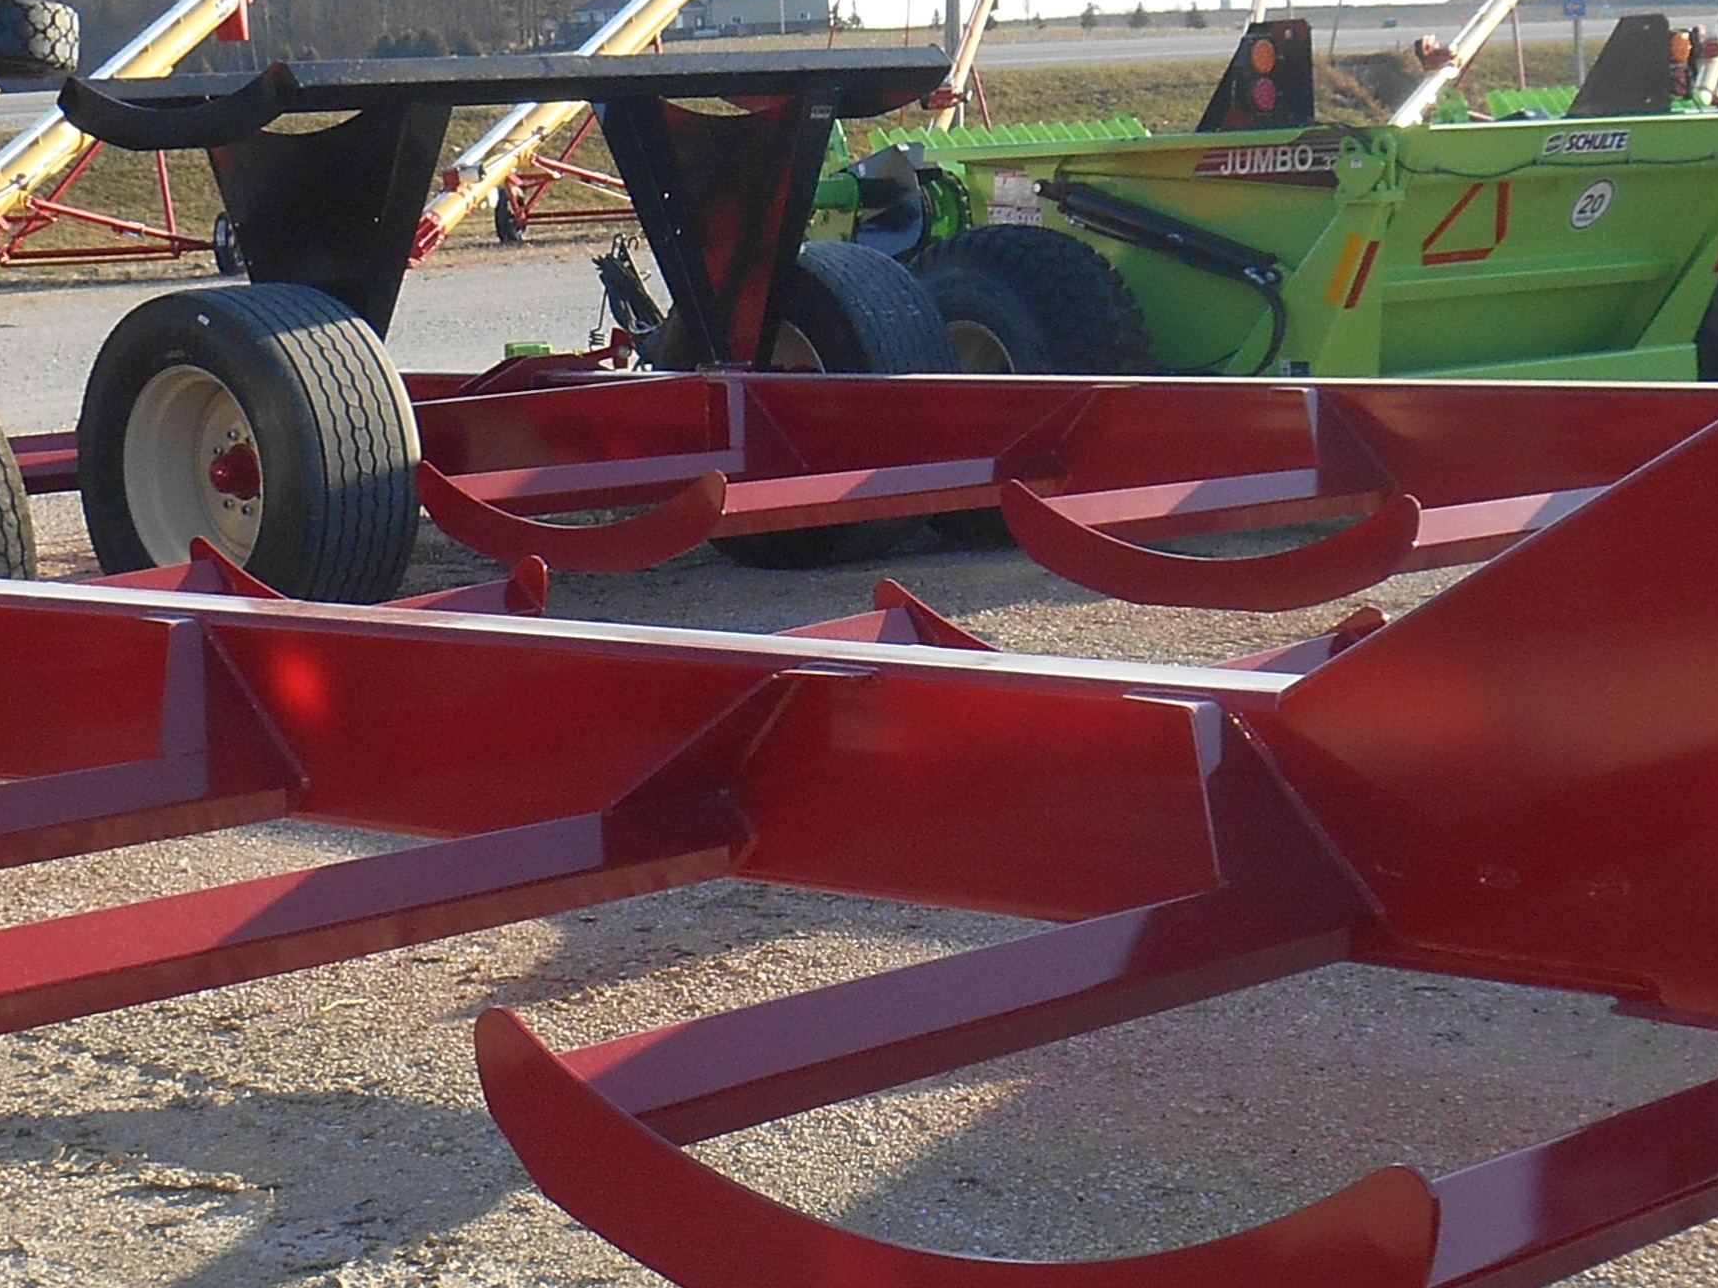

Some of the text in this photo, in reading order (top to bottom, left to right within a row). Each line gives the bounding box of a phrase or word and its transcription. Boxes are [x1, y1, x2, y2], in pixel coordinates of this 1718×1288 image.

[1565, 132, 1629, 152] SCHULTE
[1220, 143, 1314, 175] JUMBO
[1577, 193, 1605, 215] 20
